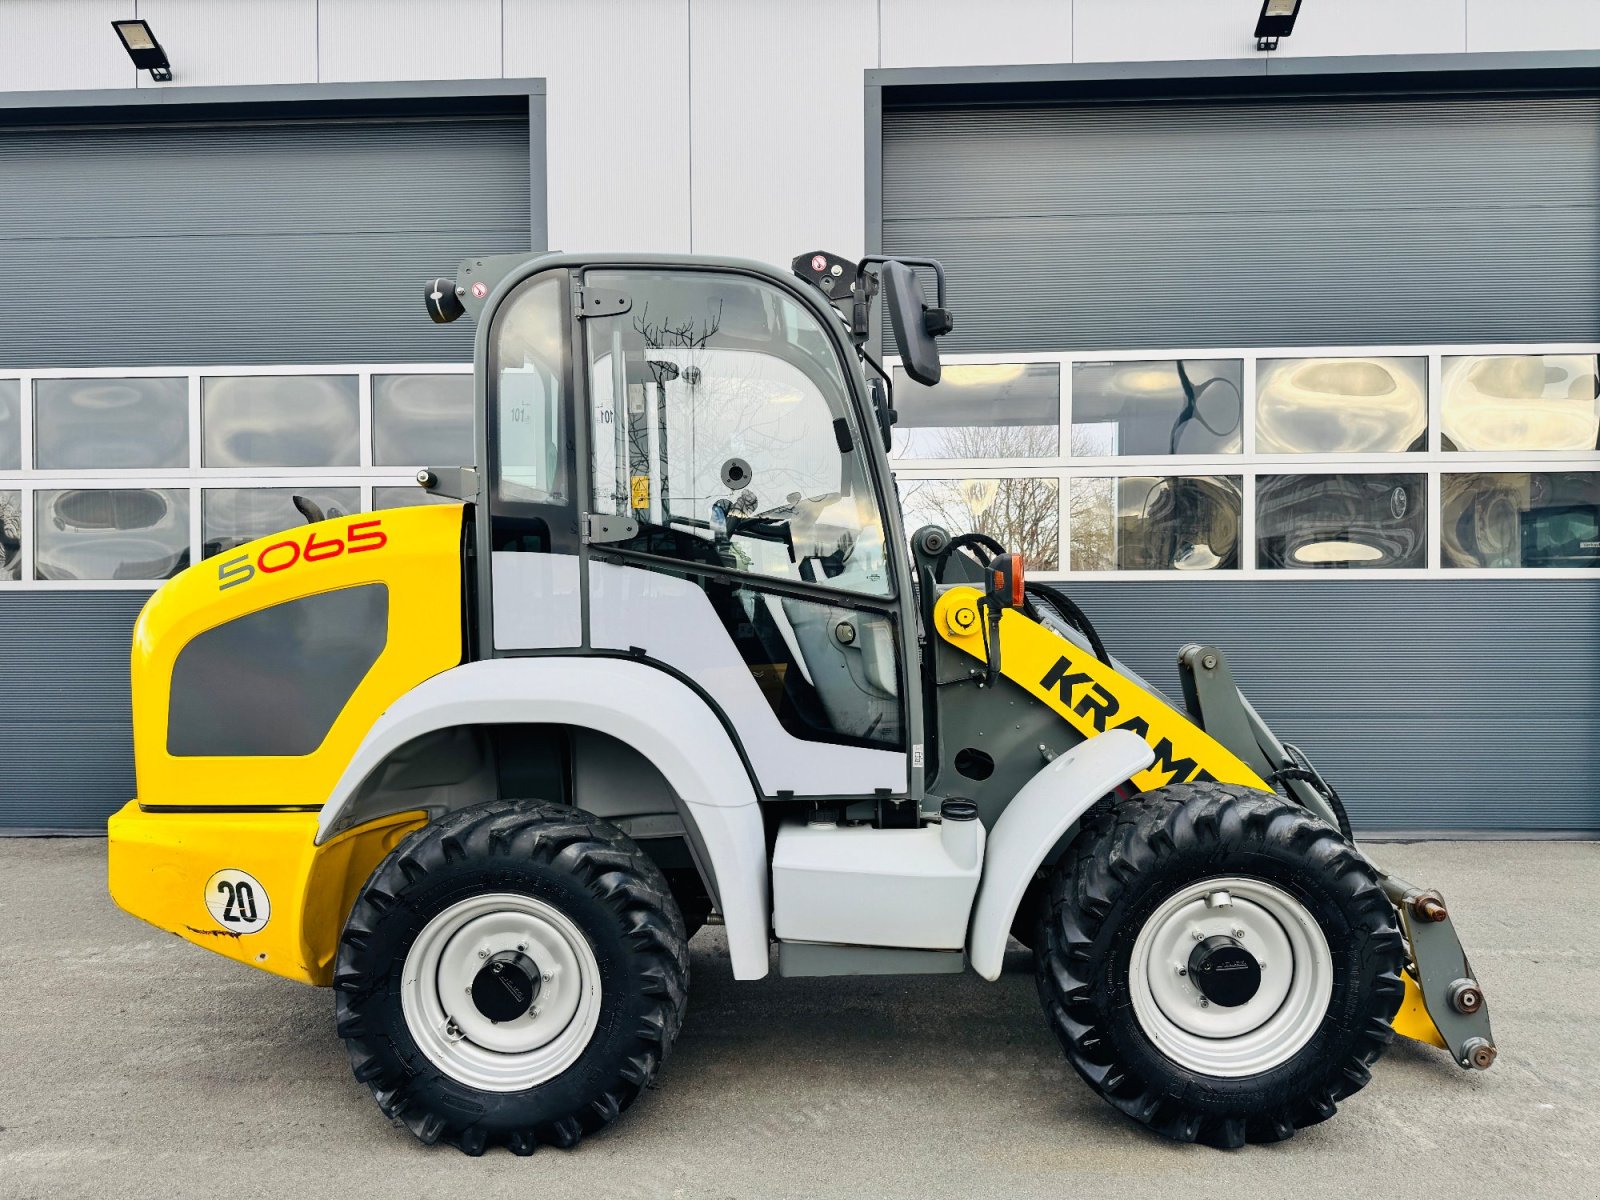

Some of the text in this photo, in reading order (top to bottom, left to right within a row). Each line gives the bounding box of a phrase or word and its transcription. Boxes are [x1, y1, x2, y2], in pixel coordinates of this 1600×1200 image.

[219, 520, 388, 591] 5065
[1039, 655, 1219, 787] KRAM
[217, 880, 258, 923] 20
